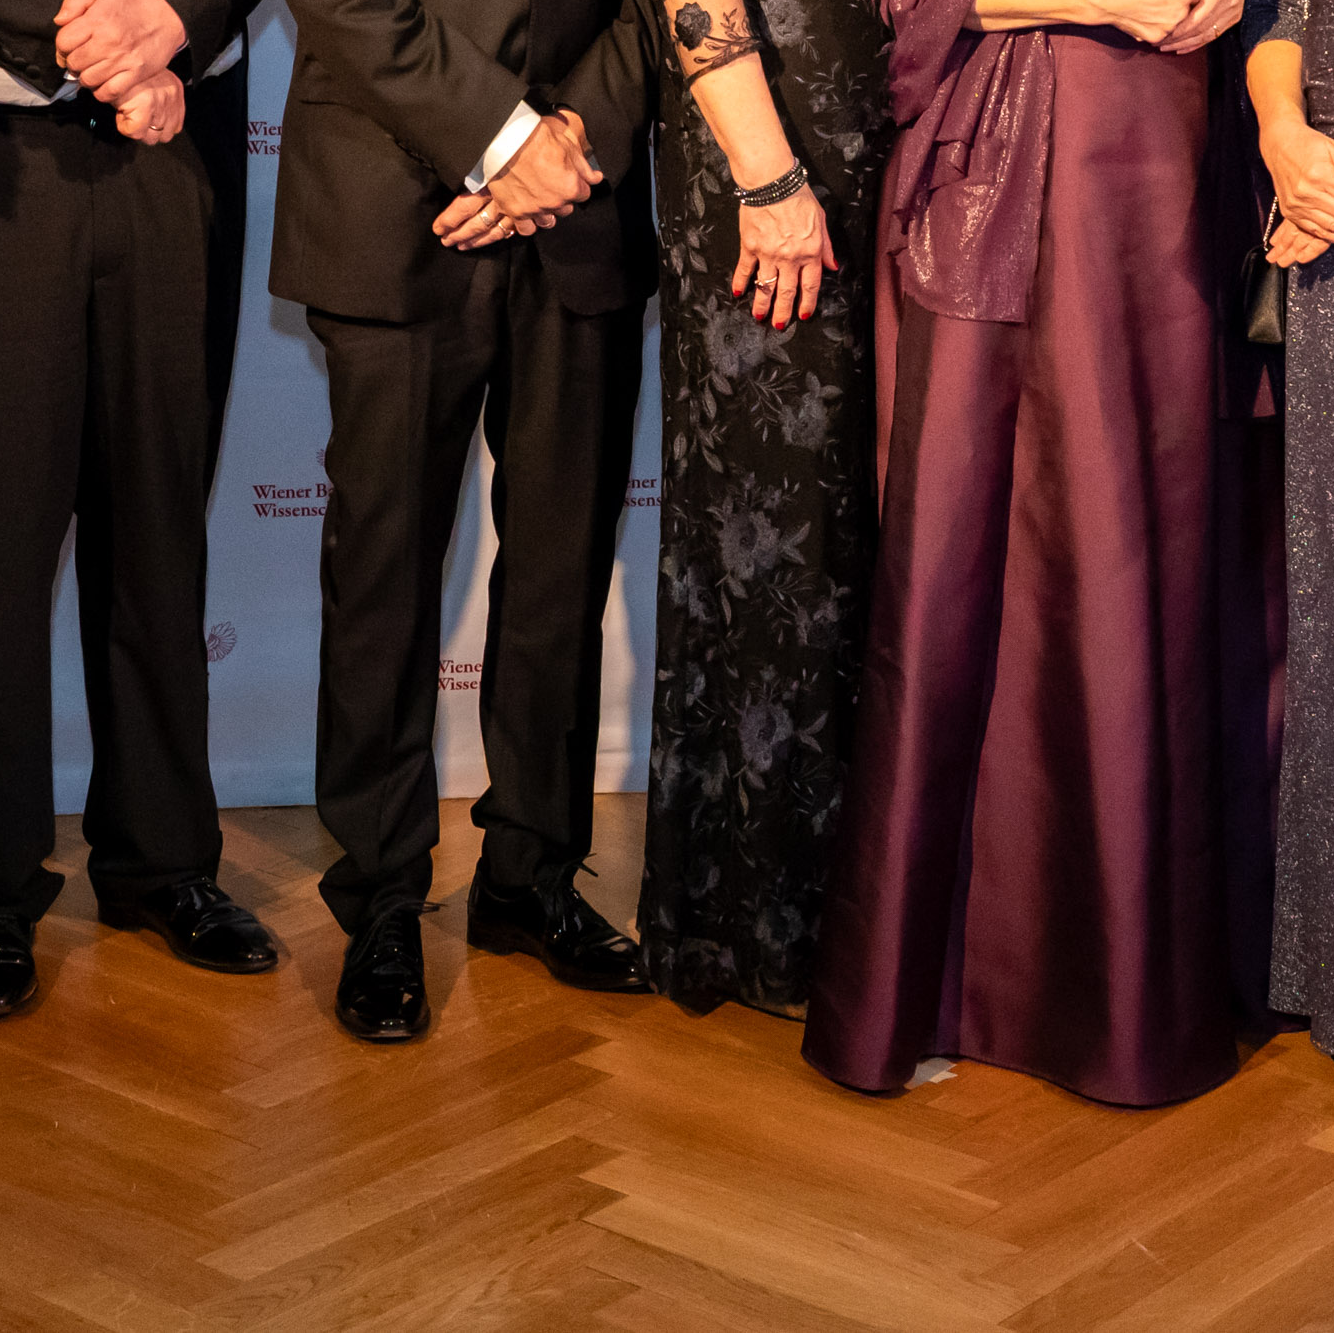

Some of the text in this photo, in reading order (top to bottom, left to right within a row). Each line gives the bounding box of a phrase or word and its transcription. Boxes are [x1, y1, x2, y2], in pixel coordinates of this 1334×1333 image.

[629, 479, 657, 488] ner
[252, 485, 312, 498] Wiener
[253, 503, 326, 517] Wissensc
[439, 660, 482, 673] Wiene
